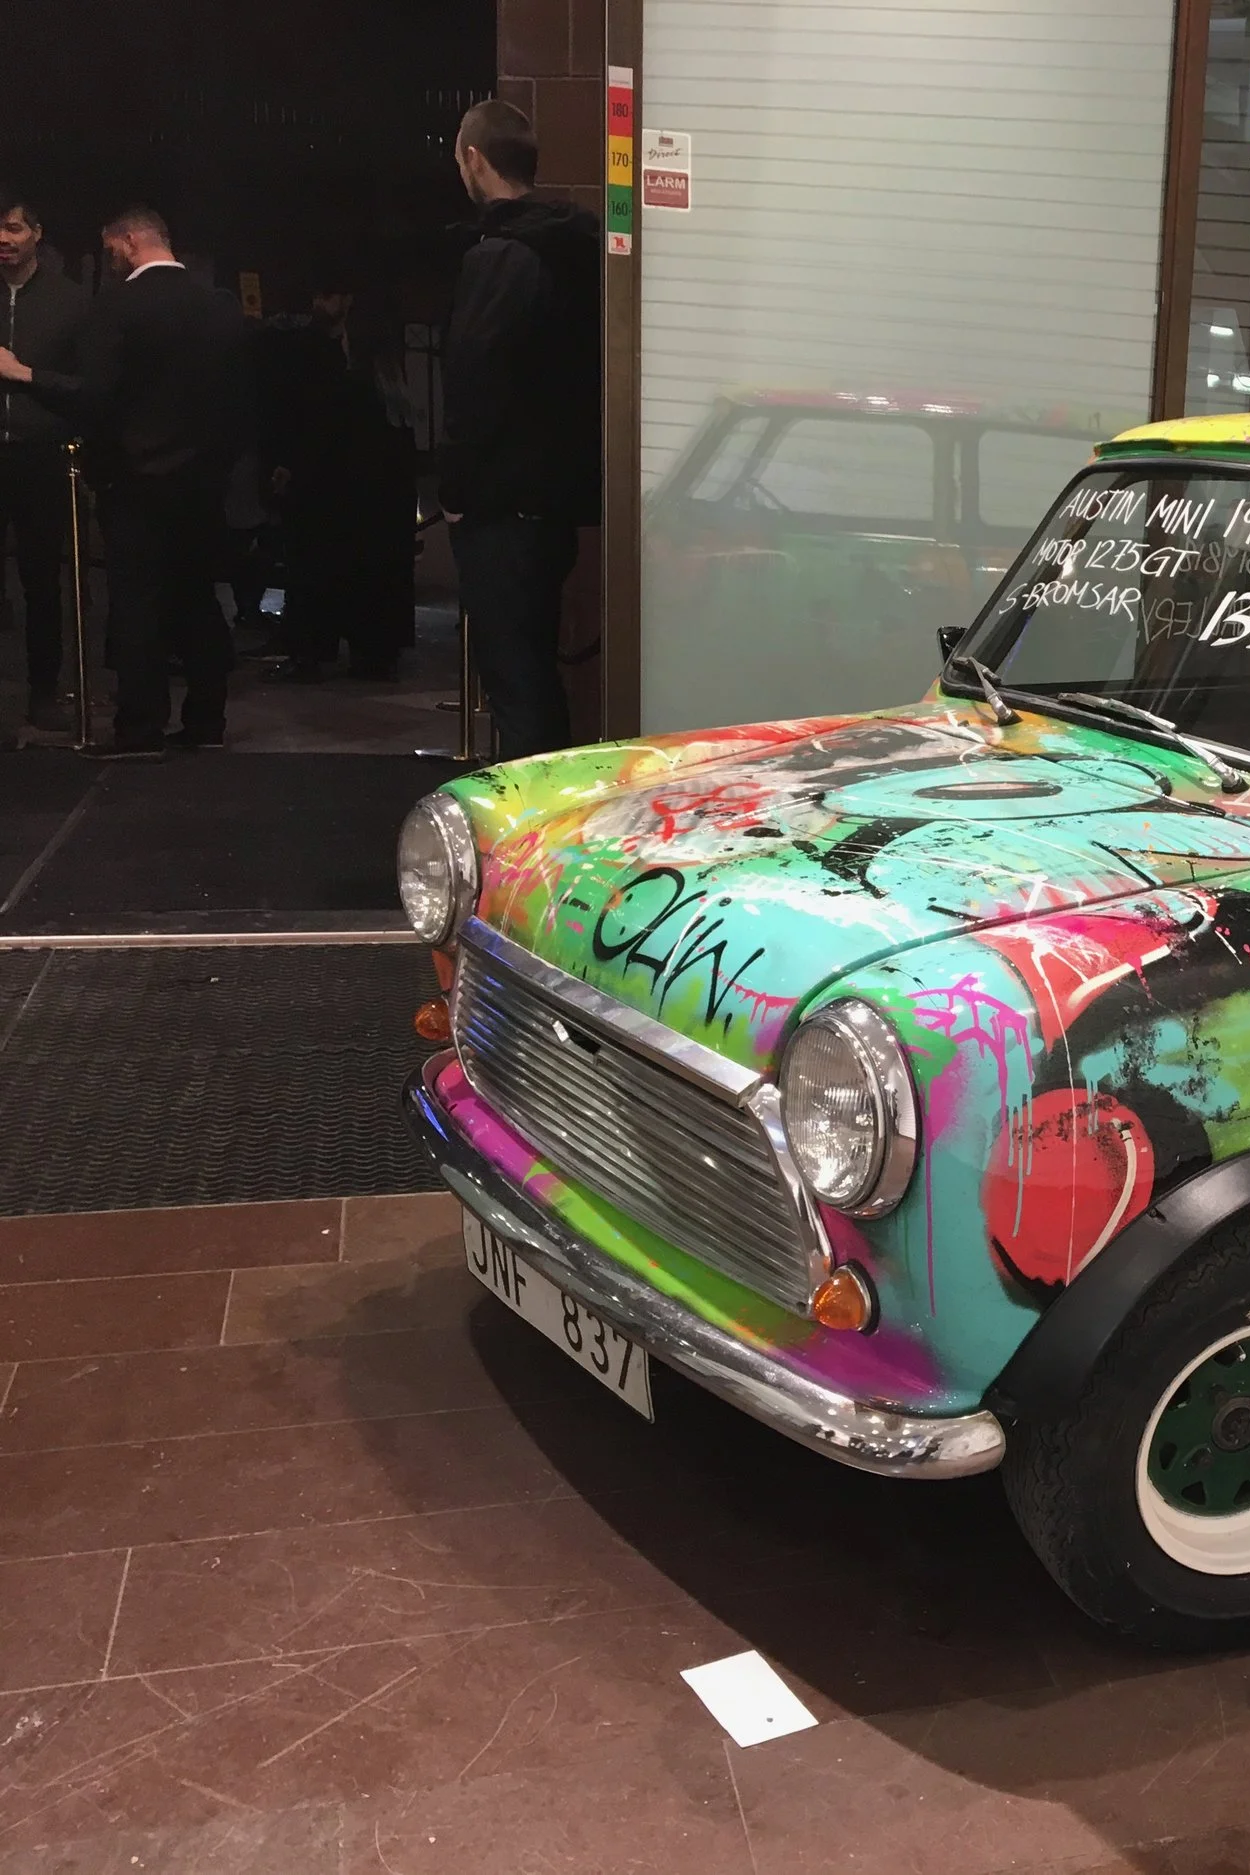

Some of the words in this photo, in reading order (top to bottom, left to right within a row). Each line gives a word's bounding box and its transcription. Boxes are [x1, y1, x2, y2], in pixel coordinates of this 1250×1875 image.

[612, 102, 629, 118] 180
[612, 151, 629, 168] 170
[646, 174, 686, 190] LARM
[611, 200, 628, 217] 160
[1059, 489, 1145, 525] AUSTIN
[1145, 494, 1215, 540] MINI
[1032, 536, 1087, 567] MOTOR
[472, 1222, 527, 1307] JNF
[560, 1290, 634, 1391] 837
